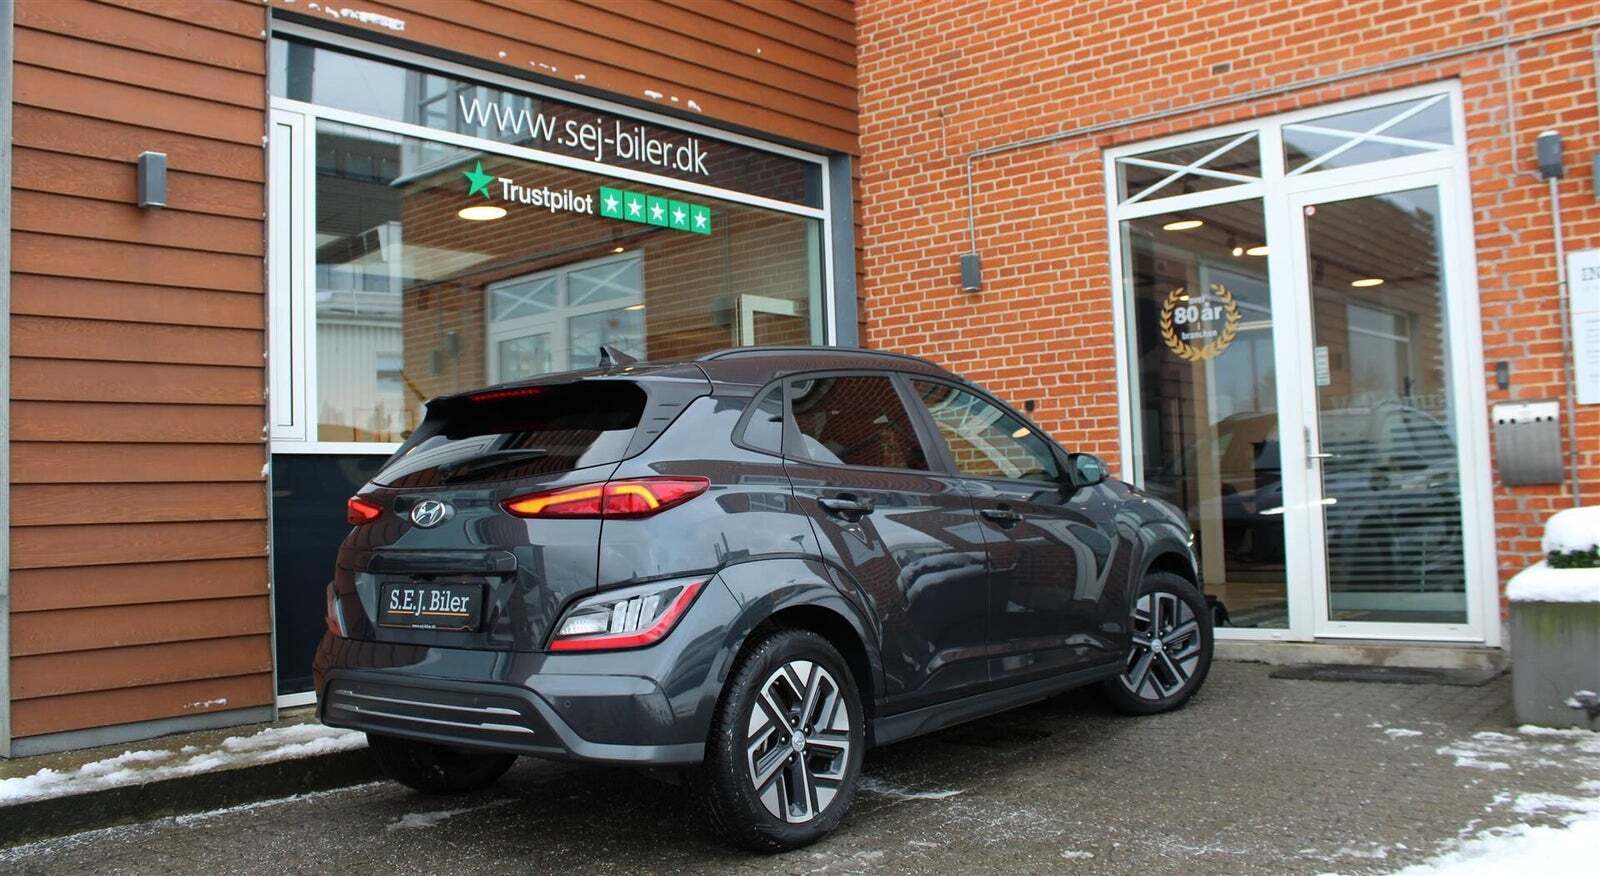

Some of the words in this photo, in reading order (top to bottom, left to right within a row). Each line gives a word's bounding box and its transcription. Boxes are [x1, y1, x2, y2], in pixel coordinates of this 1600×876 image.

[459, 94, 709, 176] www.sej-biler.dk
[498, 177, 594, 215] Trustpilot
[1174, 305, 1199, 325] 80
[1201, 302, 1223, 321] år
[389, 589, 426, 616] S.E.J.
[429, 590, 470, 613] Biler
